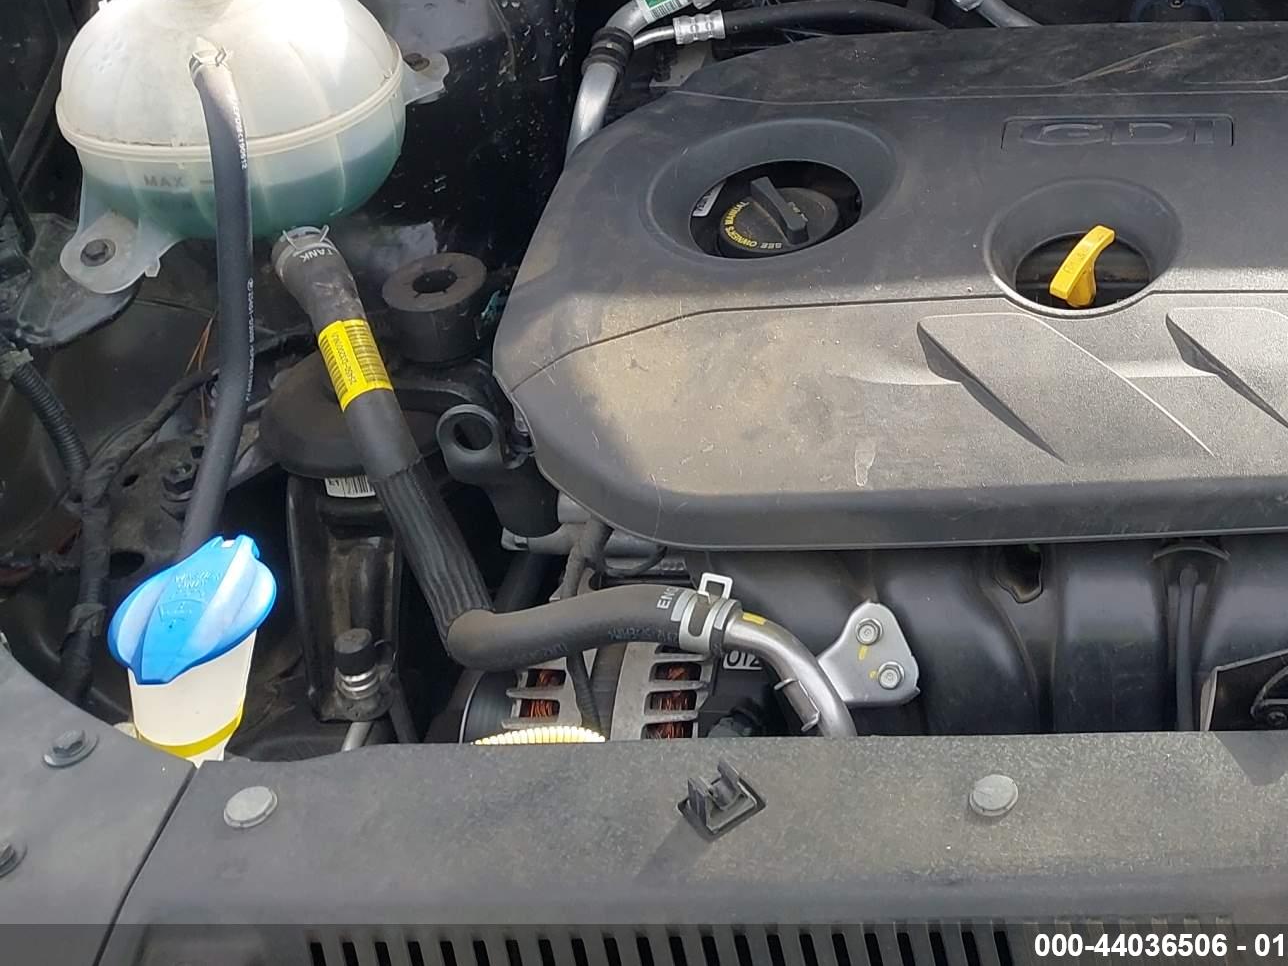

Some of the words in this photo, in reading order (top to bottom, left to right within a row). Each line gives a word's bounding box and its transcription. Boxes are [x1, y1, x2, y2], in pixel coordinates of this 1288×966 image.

[1021, 121, 1216, 145] GDI
[143, 174, 185, 187] MAX
[299, 248, 333, 263] TANK
